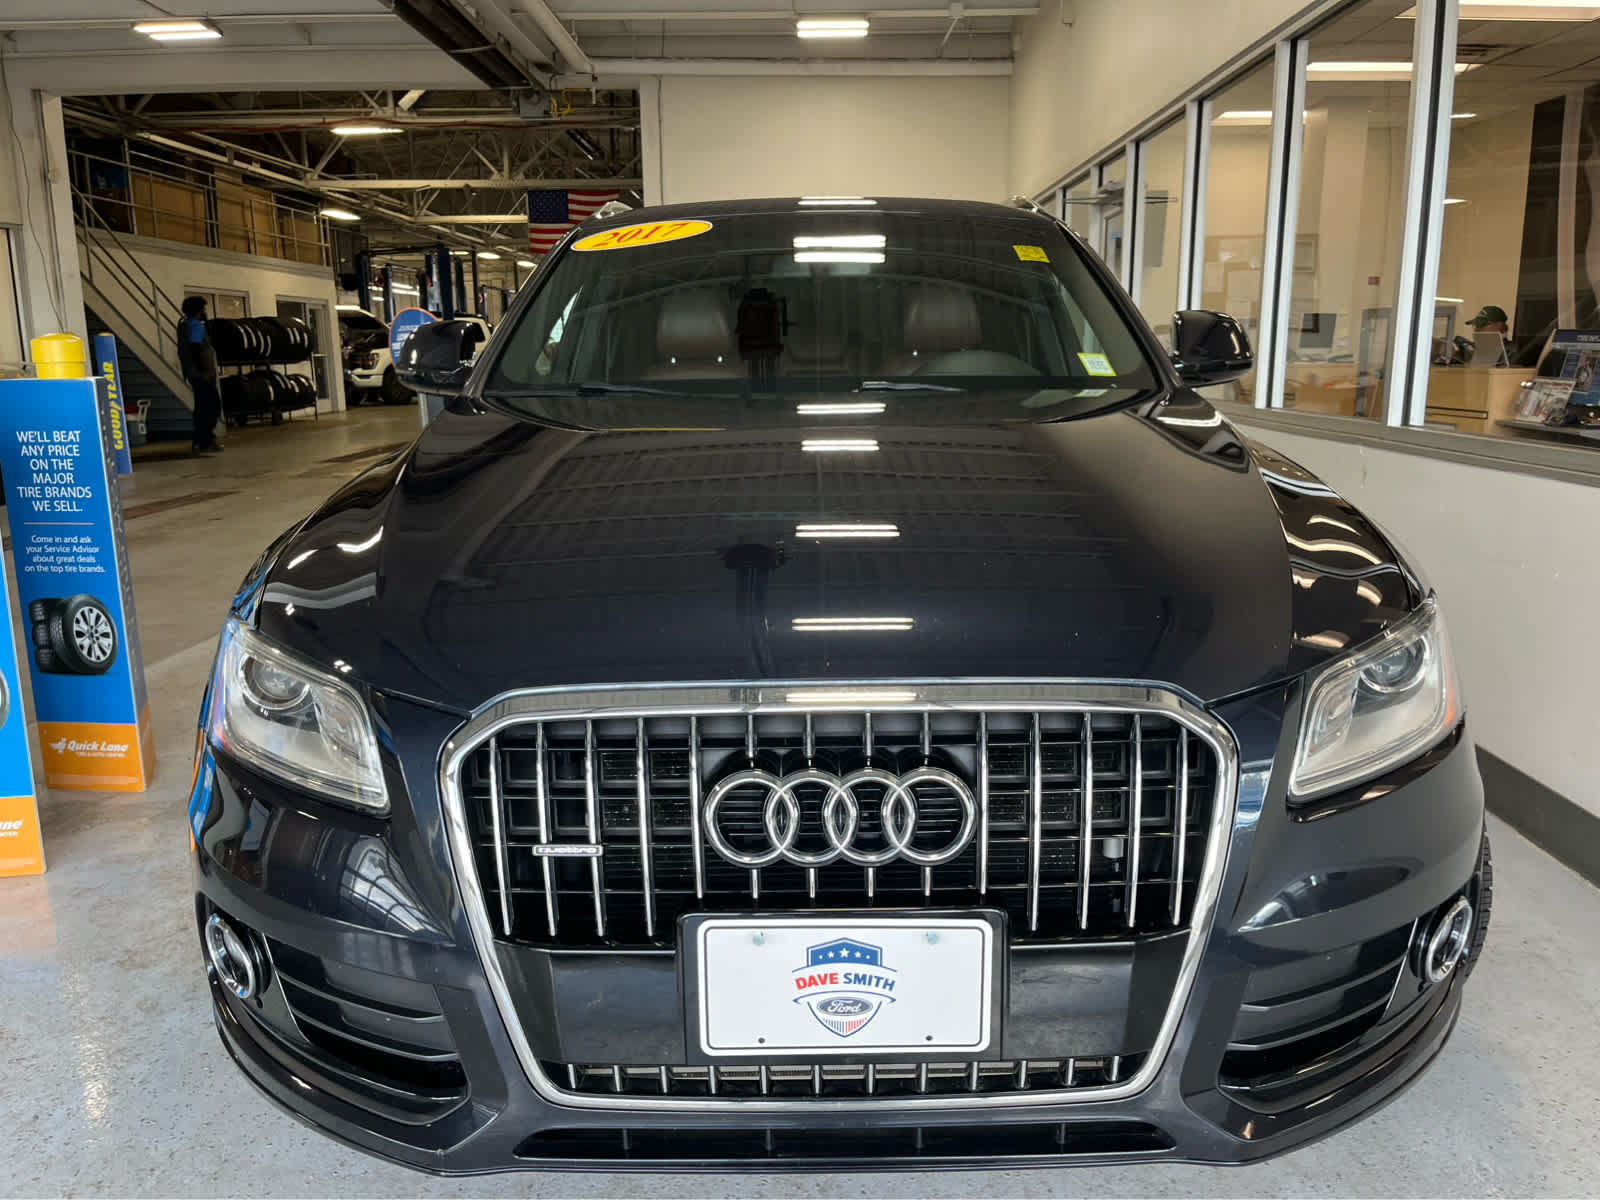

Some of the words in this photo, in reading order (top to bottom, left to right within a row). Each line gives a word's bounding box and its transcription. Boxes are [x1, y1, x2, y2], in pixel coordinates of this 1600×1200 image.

[592, 222, 689, 248] 2017
[16, 430, 51, 443] WE'LL
[53, 430, 81, 443] BEAT
[21, 444, 45, 456] ANY
[48, 444, 81, 456] PRICE
[30, 458, 49, 471] ON
[51, 458, 75, 470] THE
[33, 472, 75, 484] MAJOR
[16, 486, 42, 498] TIRE
[45, 486, 92, 498] BRANDS
[32, 500, 51, 512] WE
[54, 500, 84, 512] SELL.
[31, 535, 54, 543] Come
[55, 535, 62, 543] in
[64, 535, 79, 543] and
[80, 535, 92, 543] ask
[26, 545, 42, 554] your
[44, 545, 71, 553] Service
[73, 545, 100, 553] Advisor
[33, 555, 54, 563] about
[56, 556, 75, 565] great
[77, 555, 96, 563] deals
[25, 565, 35, 573] on
[36, 565, 49, 573] the
[51, 565, 64, 574] top
[65, 565, 78, 573] tire
[67, 740, 99, 752] Quick
[101, 740, 129, 752] Lane
[795, 973, 839, 990] DAVE
[843, 972, 896, 991] SMITH
[826, 1000, 861, 1014] Ford
